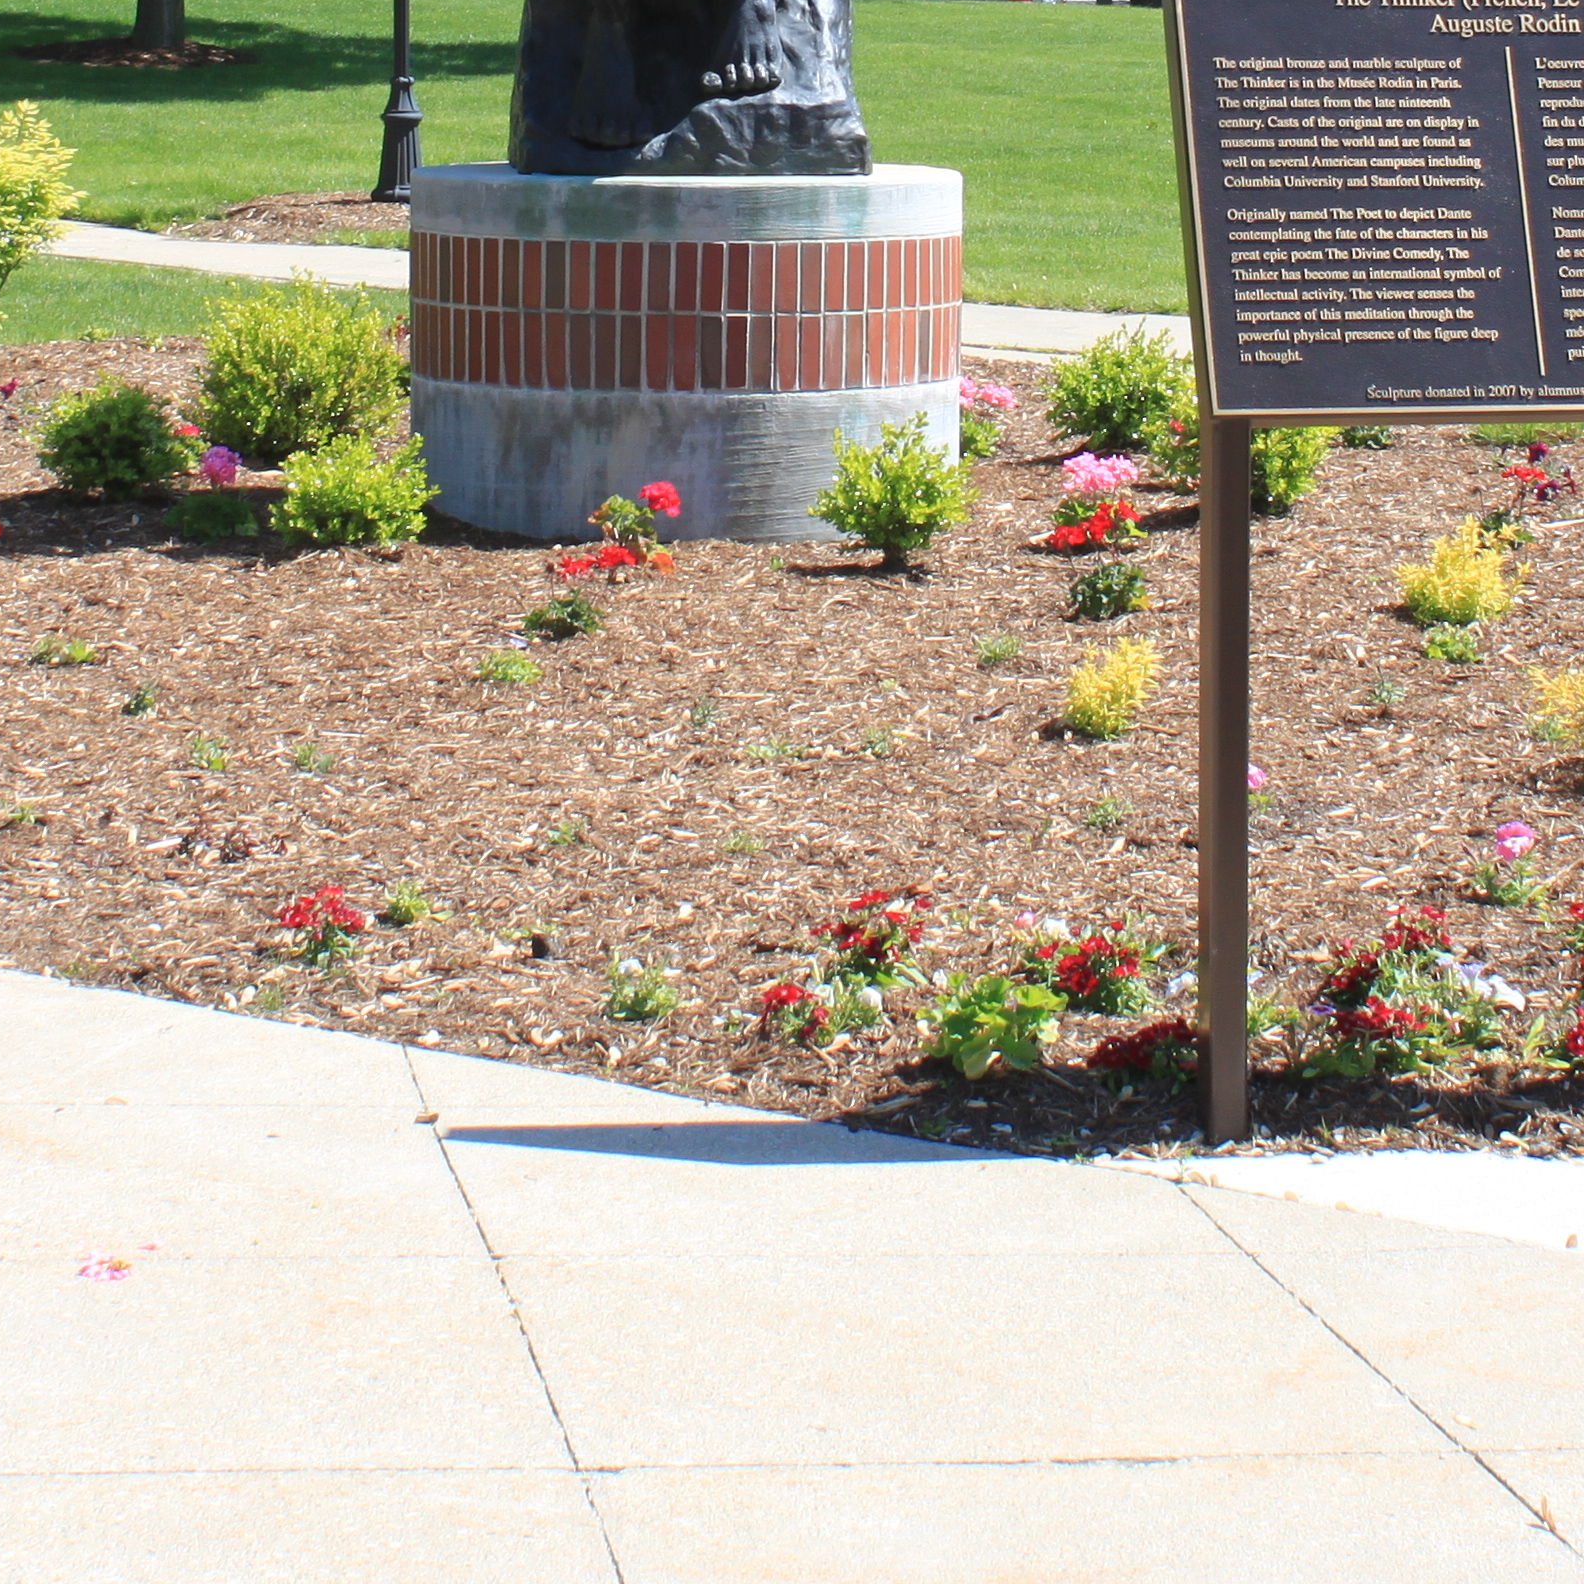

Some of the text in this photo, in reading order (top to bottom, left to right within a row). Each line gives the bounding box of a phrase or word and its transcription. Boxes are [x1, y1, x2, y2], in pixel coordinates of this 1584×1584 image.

[1429, 14, 1582, 36] Auguste Rodin
[1212, 57, 1463, 71] The original bronze and marble sculpture of
[1214, 77, 1239, 89] The
[1240, 77, 1287, 89] Thinker
[1289, 77, 1300, 89] is
[1302, 77, 1315, 89] in
[1316, 77, 1336, 89] the
[1378, 77, 1414, 89] Rodin
[1416, 77, 1428, 89] in
[1430, 77, 1462, 89] Paris.
[1218, 116, 1480, 131] century. Casts of the original are on display in
[1220, 135, 1472, 148] museums around the world and are found as
[1544, 135, 1565, 147] des
[1222, 155, 1482, 169] well on several American campuses including
[1224, 175, 1485, 190] Columbia University and Stanford University.
[1228, 227, 1489, 242] contemplating the fate of the characters in his
[1230, 247, 1470, 263] great epic poem The Divine Comedy, The
[1232, 267, 1503, 281] Thinker has become an international symbol of
[1234, 287, 1476, 302] intellectual activity. The viewer senses the
[1238, 328, 1500, 344] powerful physical presence of the figure deep
[1240, 349, 1304, 363] in thought.
[1367, 385, 1423, 401] Sculpture
[1424, 384, 1471, 397] donated
[1473, 384, 1486, 397] in
[1488, 384, 1517, 397] 2007
[1519, 384, 1535, 400] by
